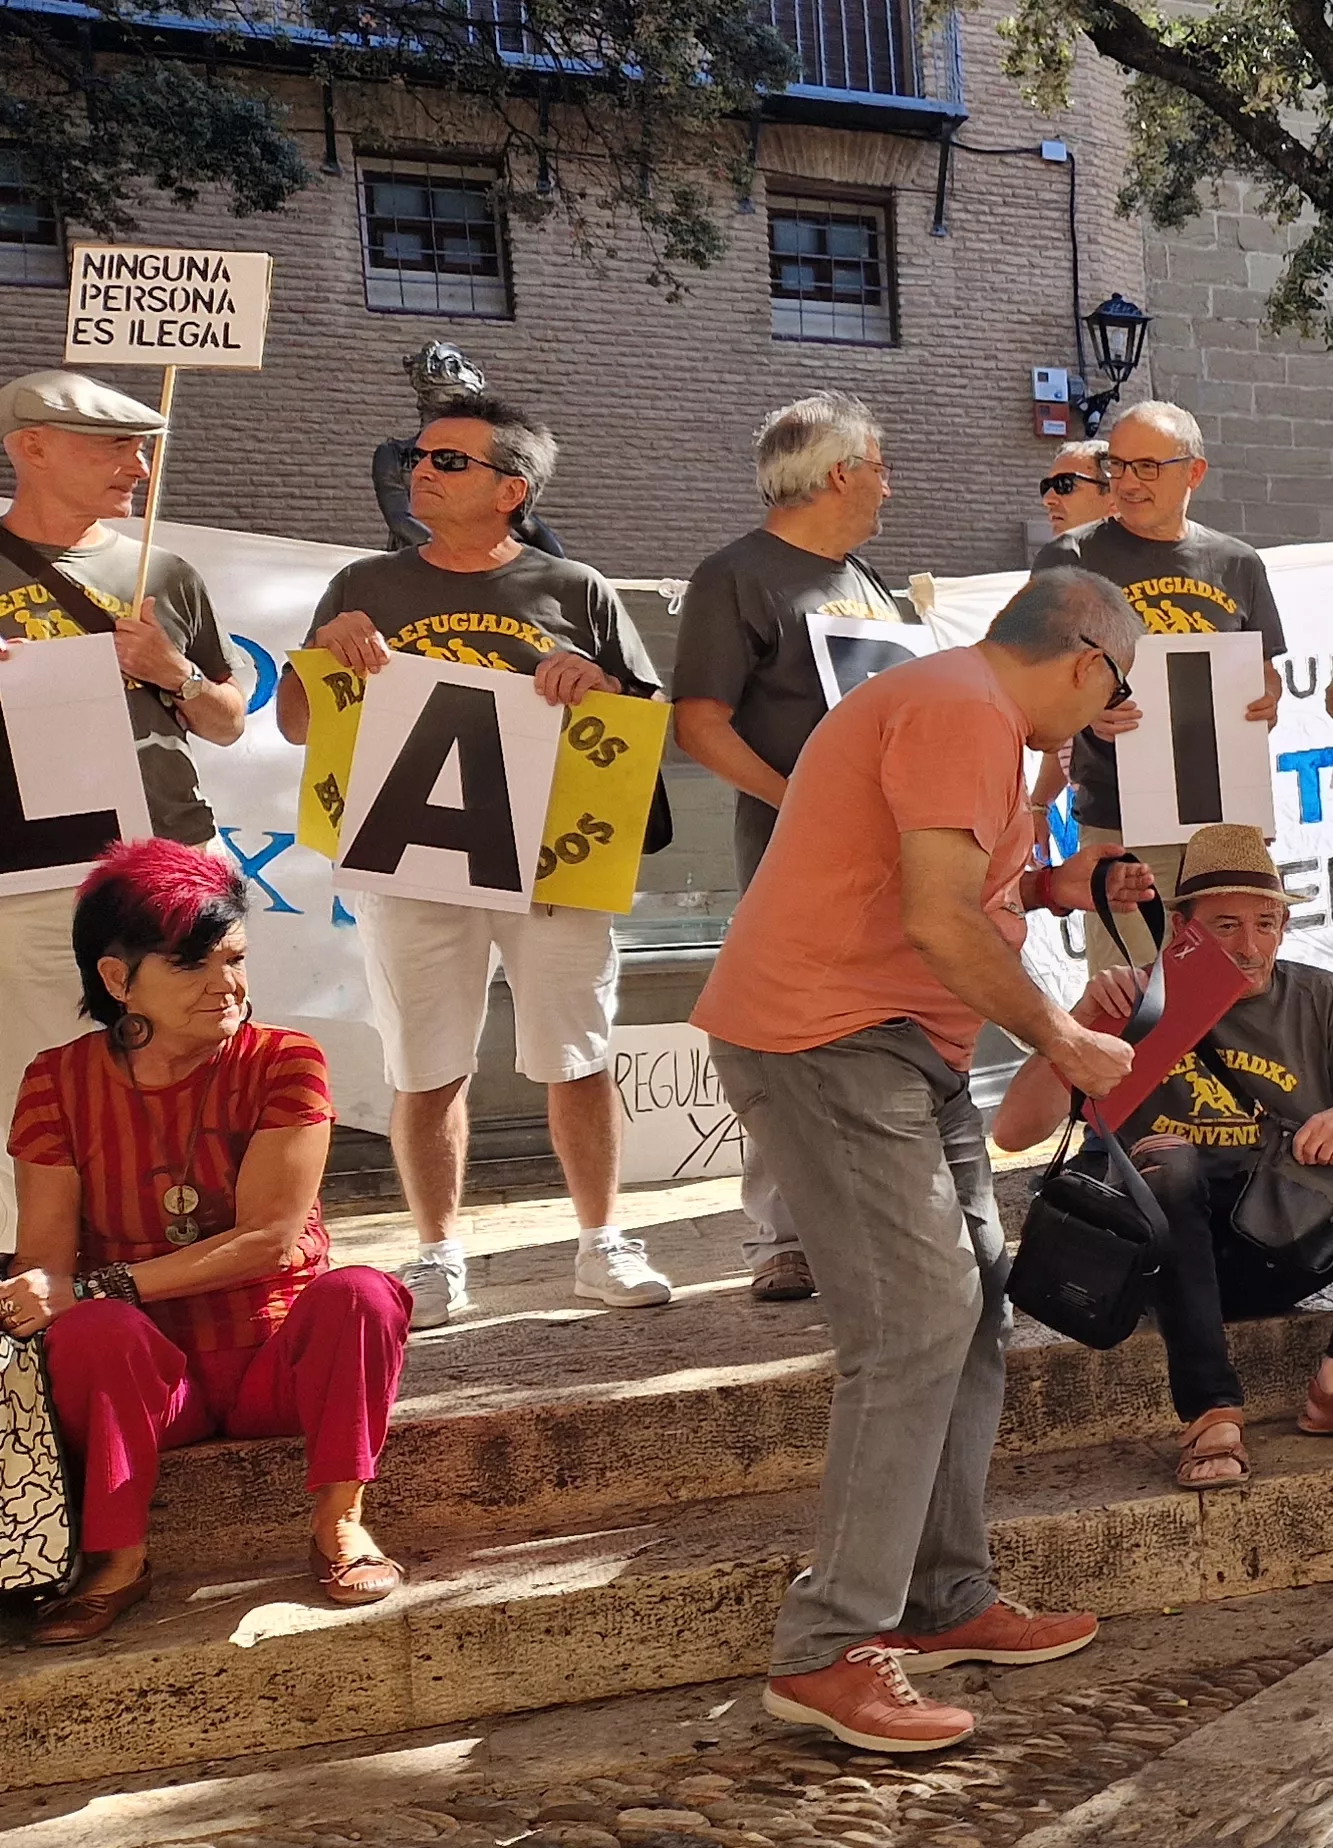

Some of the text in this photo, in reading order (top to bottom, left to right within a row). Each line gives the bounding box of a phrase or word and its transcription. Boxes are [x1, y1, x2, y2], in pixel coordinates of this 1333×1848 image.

[82, 253, 231, 283] NINGUNA
[80, 283, 236, 314] PERSONA
[72, 317, 241, 349] ES ILEGAL
[1121, 576, 1237, 614] EFUGIADXS
[341, 681, 523, 893] A
[615, 1048, 728, 1123] REGULA
[672, 1112, 747, 1177] YA
[1151, 1114, 1260, 1146] BIENVENI
